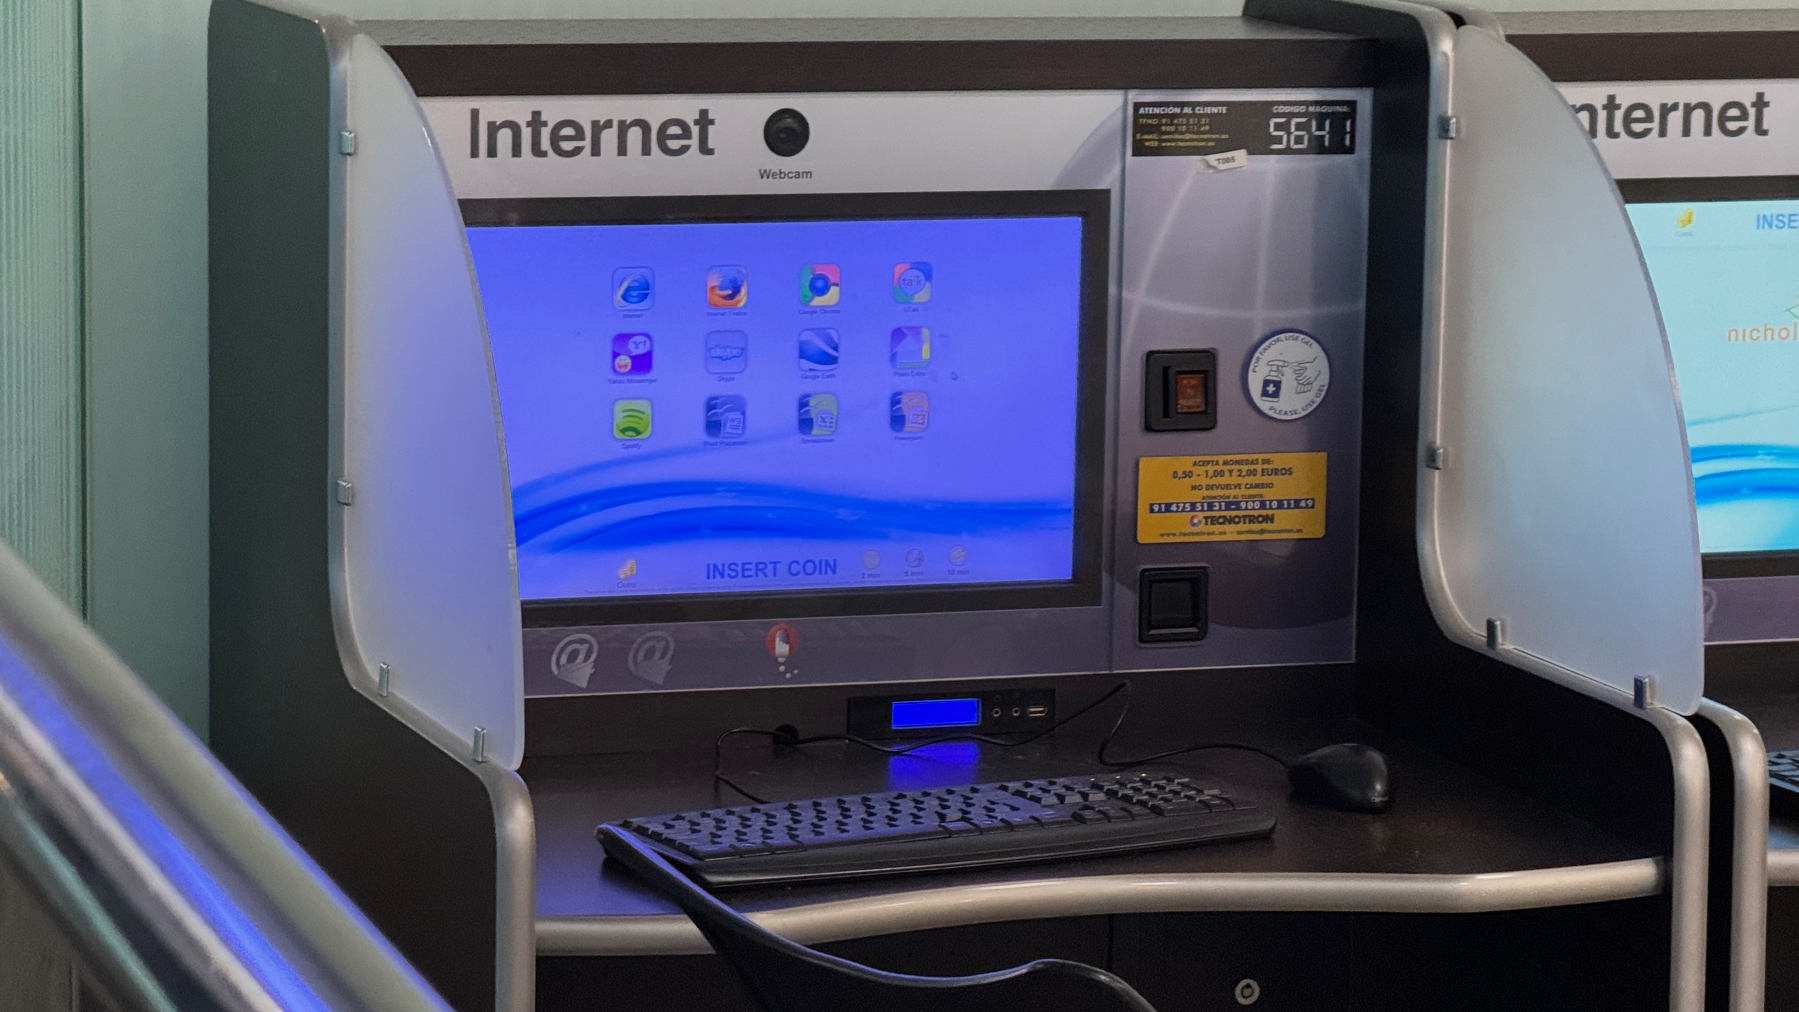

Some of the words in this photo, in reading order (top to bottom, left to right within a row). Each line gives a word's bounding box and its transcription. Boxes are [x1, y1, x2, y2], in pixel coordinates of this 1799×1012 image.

[1138, 105, 1181, 114] ATENCIÓN
[1182, 106, 1194, 114] AL
[1195, 105, 1228, 114] CLIENTE
[470, 108, 715, 159] Internet
[1269, 117, 1352, 149] 5641
[759, 168, 813, 180] Webcam
[1756, 213, 1799, 230] INSE
[1252, 355, 1262, 373] POR
[1300, 337, 1314, 348] GEL
[717, 375, 736, 383] Skype
[1301, 400, 1317, 412] USE
[622, 442, 642, 450] Spotify
[1222, 458, 1259, 466] MONEDAS
[1172, 470, 1194, 480] 0,50
[1204, 469, 1225, 479] 1,00
[1228, 469, 1235, 477] Y
[1237, 468, 1258, 478] 2,00
[1260, 467, 1294, 477] EUROS
[1152, 504, 1165, 512] 91
[1170, 503, 1191, 511] 475
[1195, 502, 1208, 511] 51
[1213, 502, 1226, 510] 31
[1240, 501, 1260, 509] 900
[1265, 500, 1278, 509] 10
[1283, 500, 1295, 508] 11
[1299, 499, 1314, 508] 49
[1203, 513, 1275, 526] TECNOTRON
[706, 560, 782, 580] INSERT
[788, 559, 838, 577] COIN
[616, 581, 637, 589] Coins
